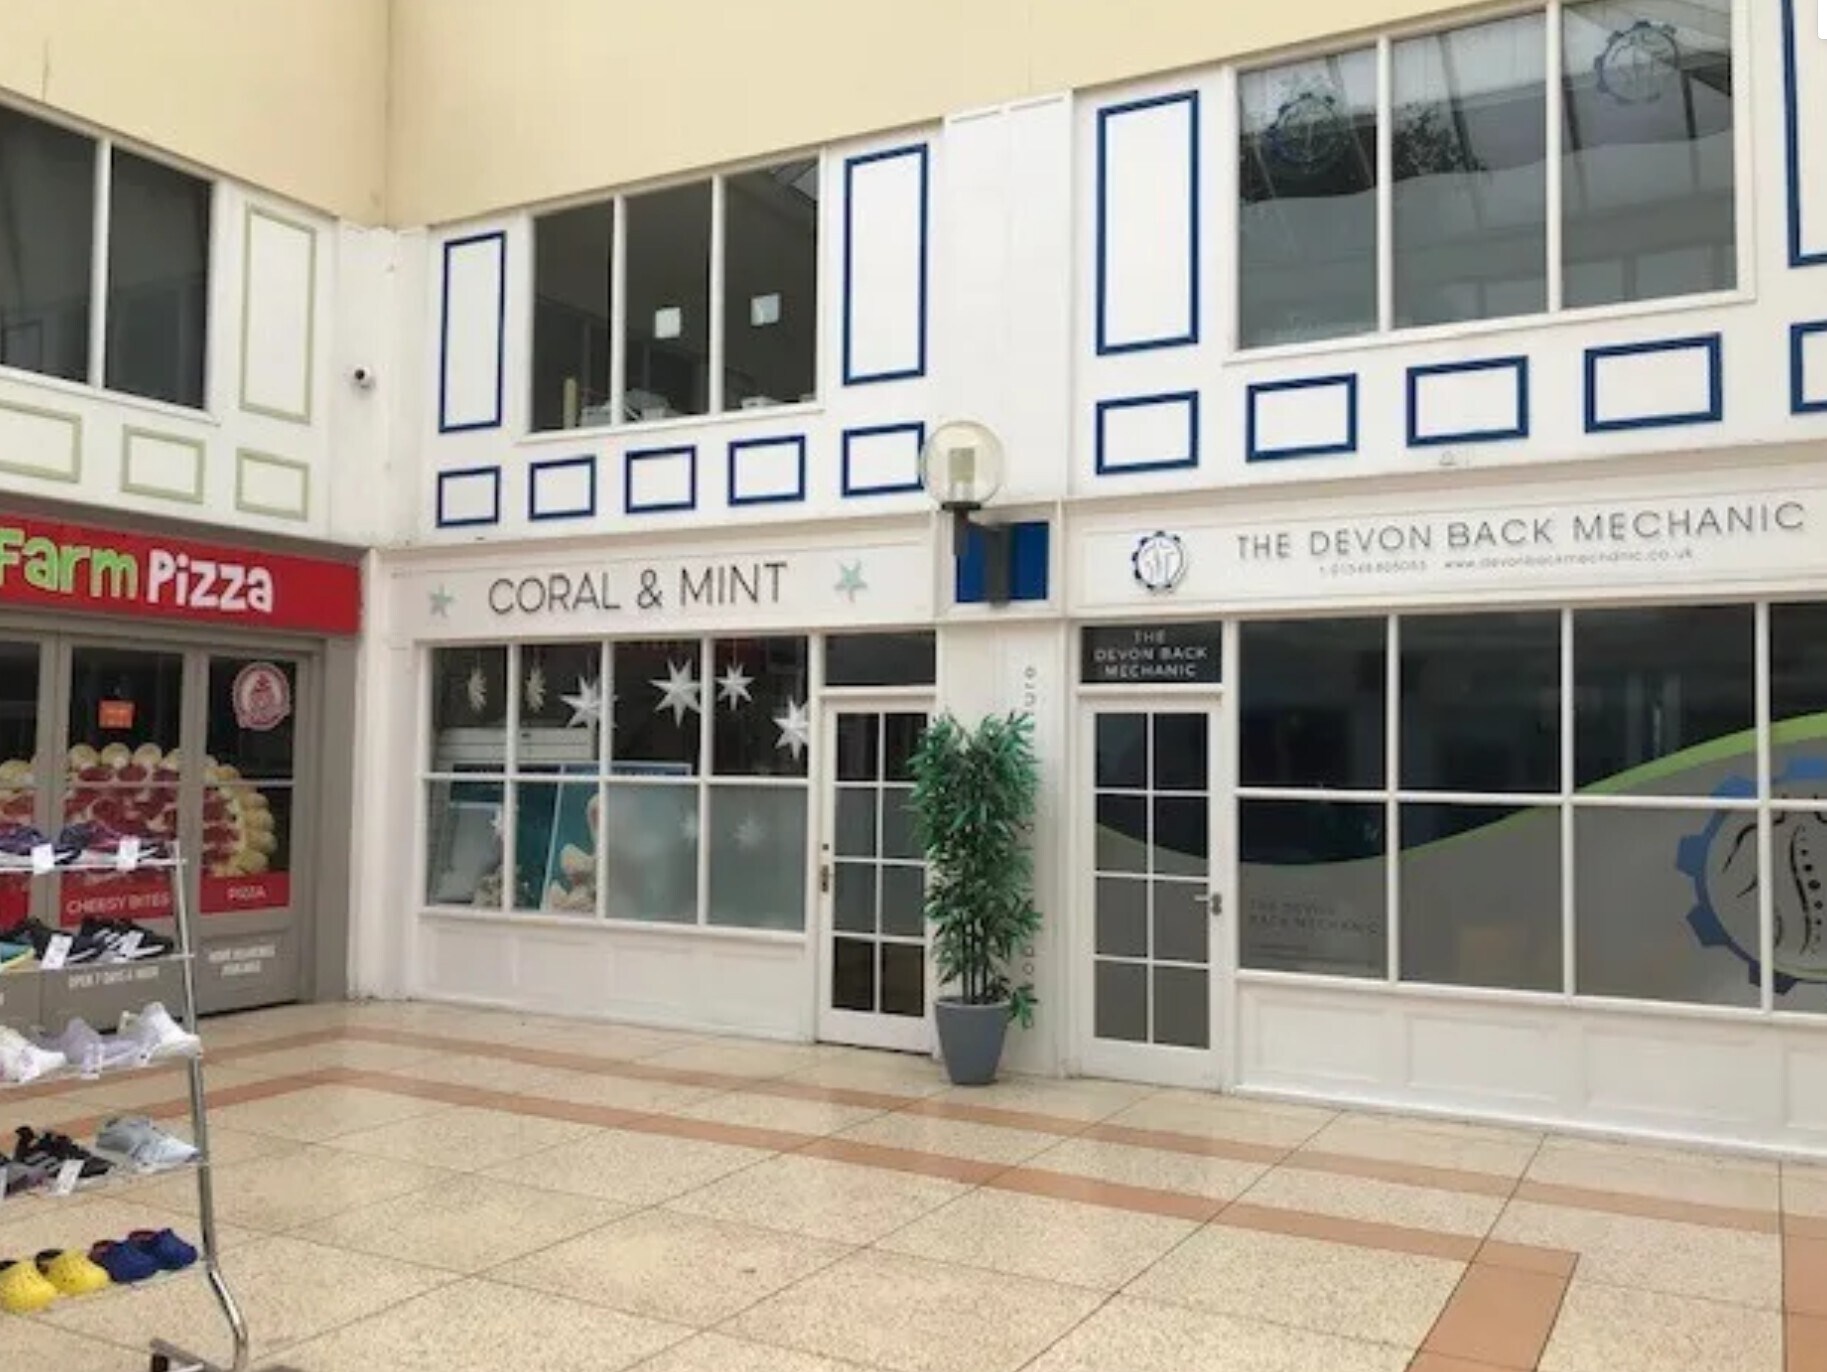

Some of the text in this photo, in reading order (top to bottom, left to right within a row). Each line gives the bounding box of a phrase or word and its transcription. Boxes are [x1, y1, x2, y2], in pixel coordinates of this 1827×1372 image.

[1237, 500, 1805, 561] THE DEVON BACK MECHANIC
[0, 527, 274, 613] Farm Pizza
[488, 561, 788, 615] CORAL & MINT
[1094, 644, 1208, 662] DEVON BACK
[1133, 629, 1165, 643] THE
[1105, 662, 1197, 678] MECHANIC
